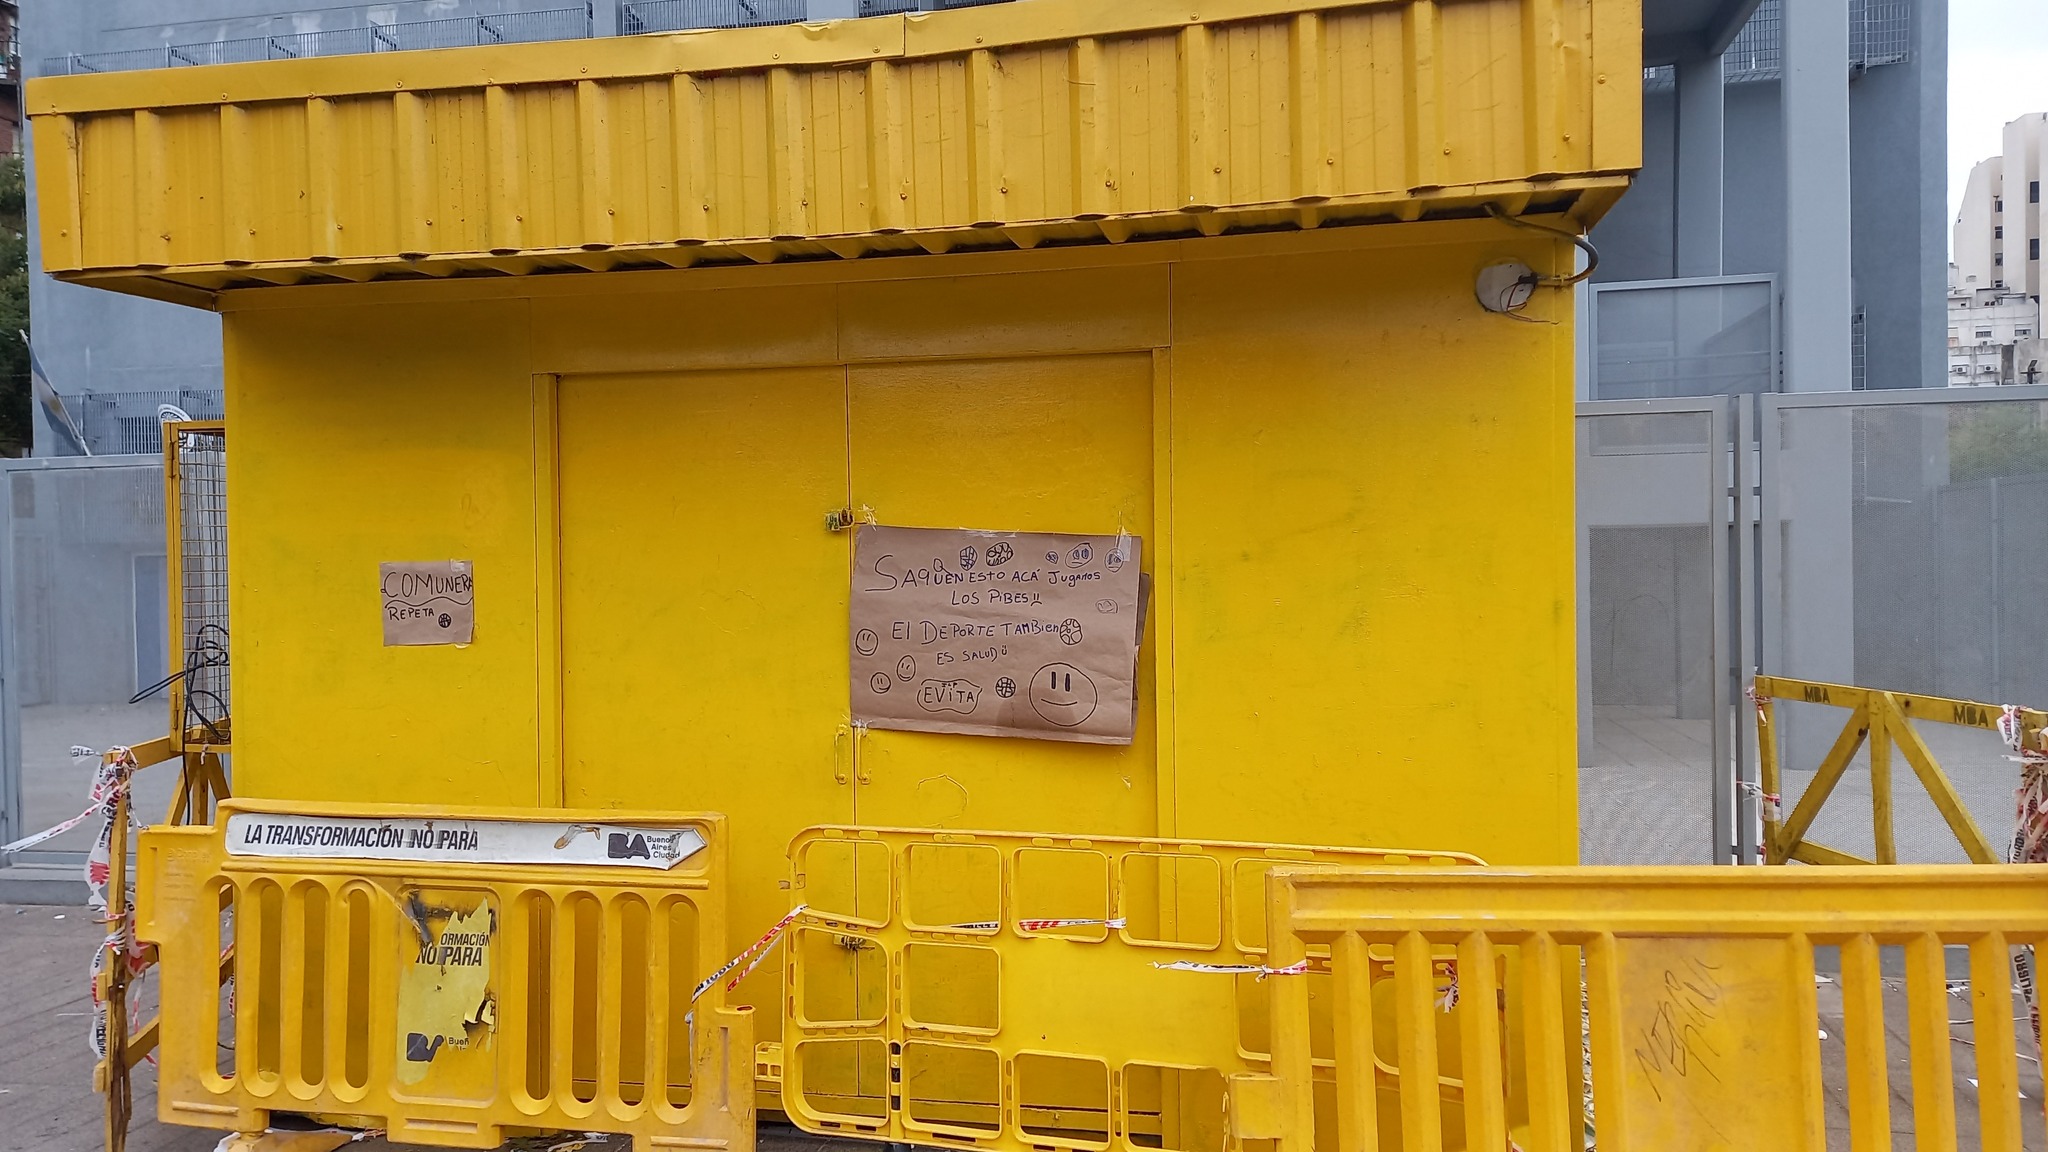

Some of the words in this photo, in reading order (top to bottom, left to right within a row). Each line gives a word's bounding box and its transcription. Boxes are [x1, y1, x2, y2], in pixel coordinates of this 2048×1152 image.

[968, 571, 1006, 583] ESTO
[1011, 568, 1040, 583] ACÁ
[951, 590, 980, 606] LOS
[387, 606, 435, 621] REPETA
[919, 620, 996, 645] DEPORTE
[936, 652, 955, 666] ES
[962, 646, 999, 663] SALUD
[1954, 704, 1989, 728] MBA
[244, 824, 262, 845] LA
[266, 825, 404, 849] TRANSFORMACIÓN
[406, 828, 434, 849] NO
[435, 829, 478, 851] PARA
[651, 843, 672, 852] Aires
[652, 850, 681, 860] Ciudad
[415, 944, 438, 966] NO
[438, 945, 483, 967] PARA
